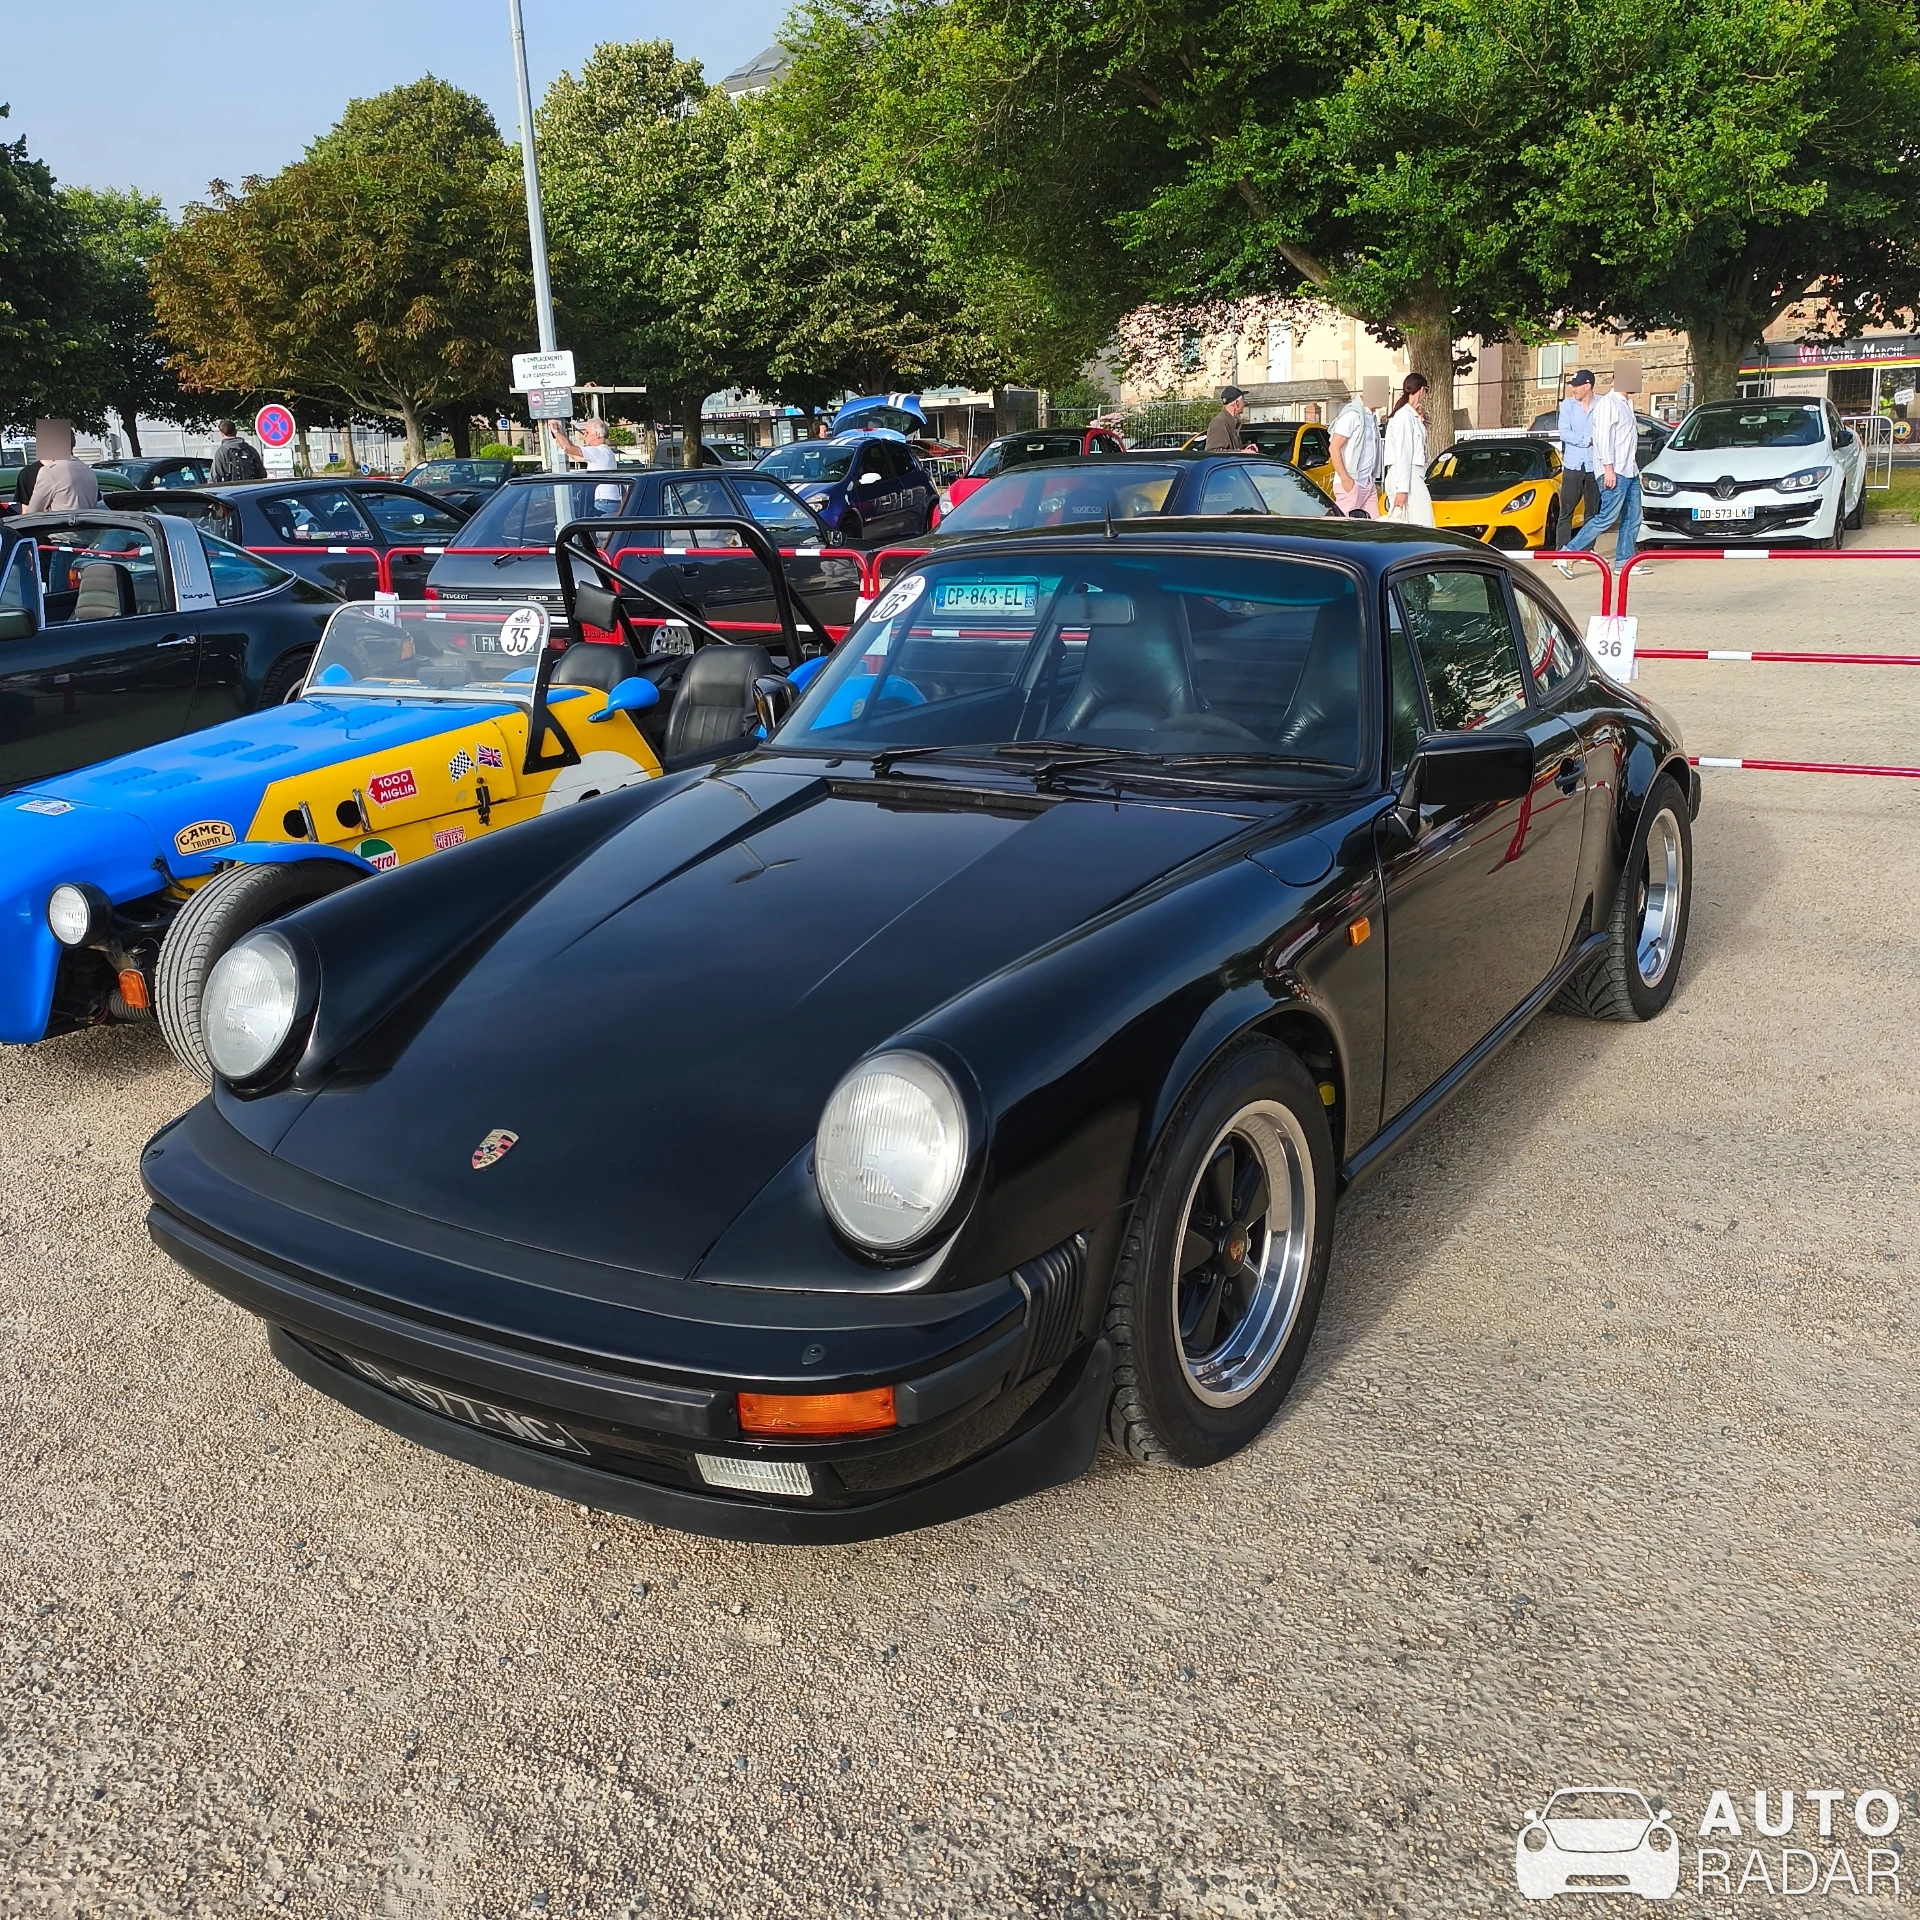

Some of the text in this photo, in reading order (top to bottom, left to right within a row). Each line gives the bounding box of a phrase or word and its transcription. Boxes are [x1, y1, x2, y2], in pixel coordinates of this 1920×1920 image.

[1072, 504, 1102, 513] sparco
[1699, 508, 1747, 519] DD-573-LX
[442, 592, 469, 600] PEUGEOT
[947, 586, 1023, 606] CP-843-EL
[379, 607, 389, 619] 34
[872, 593, 908, 619] 36
[506, 627, 531, 652] 35
[1597, 640, 1622, 657] 36
[378, 773, 409, 788] 1000
[380, 784, 415, 801] MIGLIA
[180, 824, 230, 845] CAMEL
[190, 836, 222, 849] TROPHY
